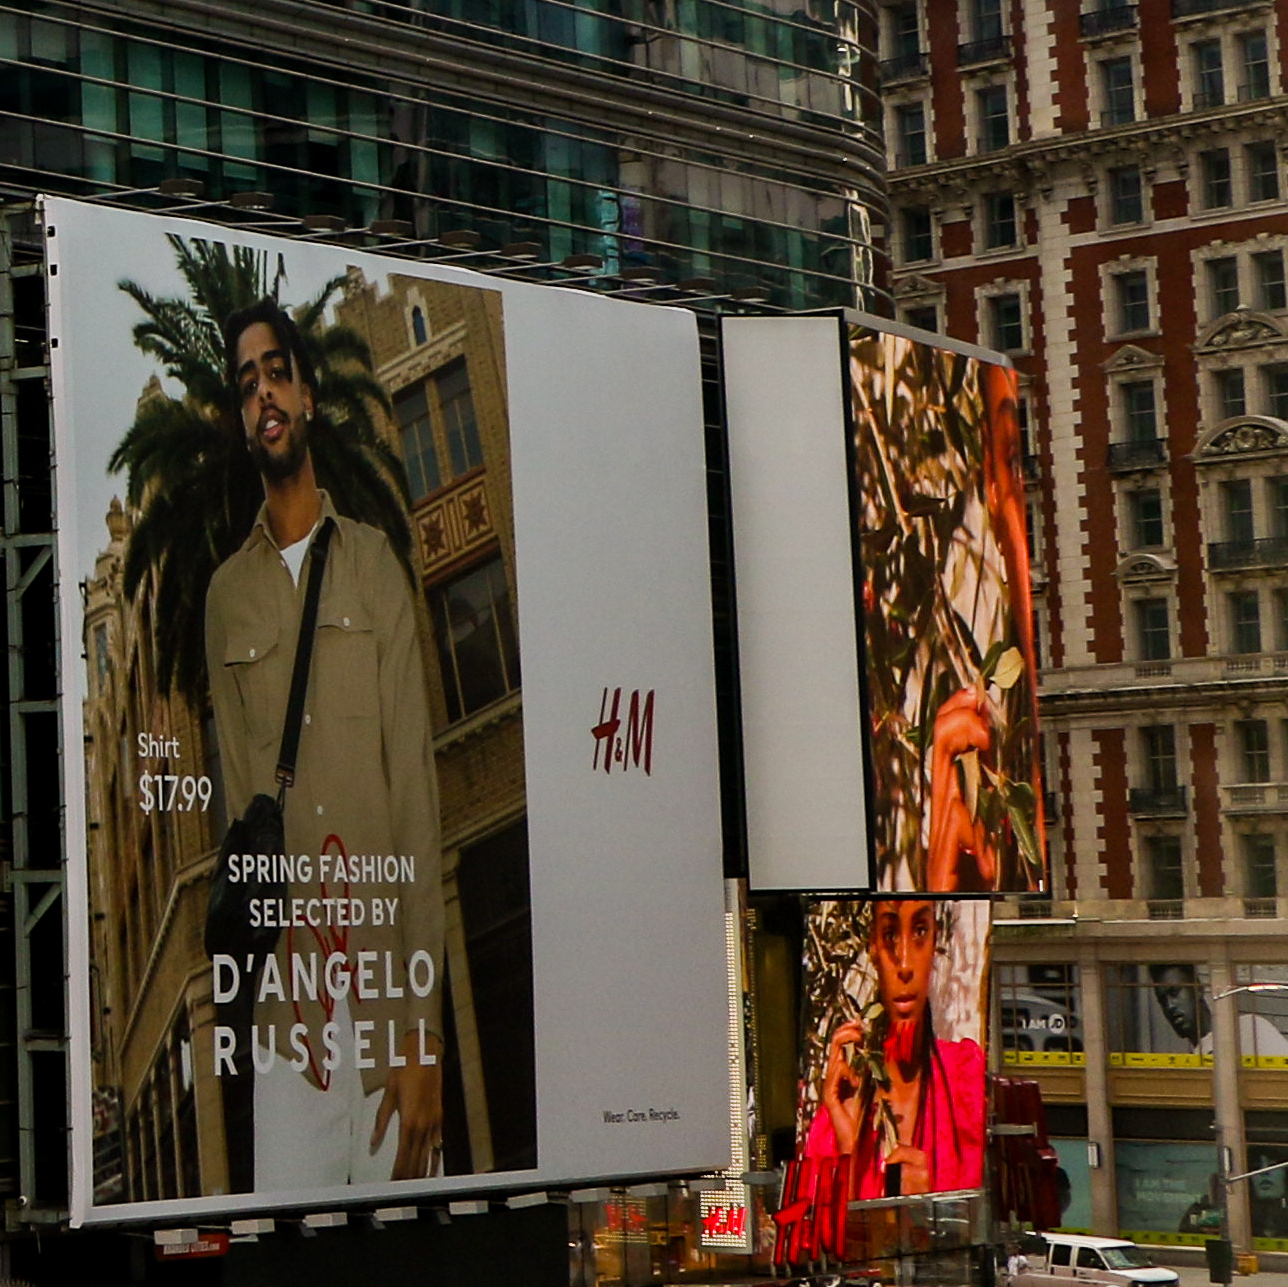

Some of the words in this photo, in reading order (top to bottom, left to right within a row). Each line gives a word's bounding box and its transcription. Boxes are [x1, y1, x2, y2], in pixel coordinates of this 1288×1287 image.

[137, 732, 181, 759] Shirt
[591, 686, 655, 777] H&M
[139, 769, 213, 816] $17.99
[227, 853, 314, 884] SPRING
[319, 854, 416, 884] FASHION
[248, 898, 366, 928] SELECTED
[371, 897, 399, 927] BY
[212, 949, 435, 1005] D'ANGELO
[213, 1018, 438, 1077] RUSSELL
